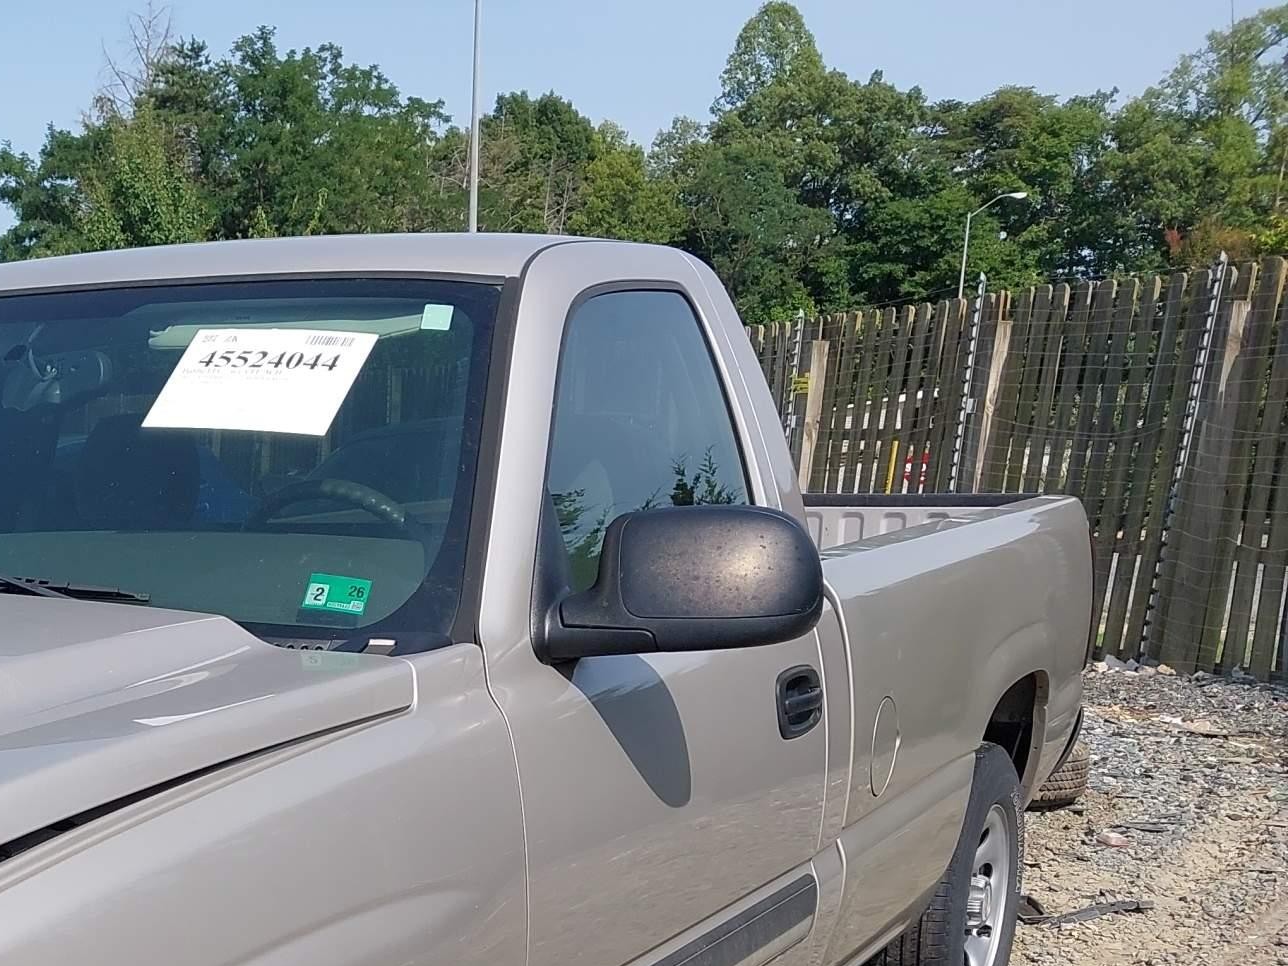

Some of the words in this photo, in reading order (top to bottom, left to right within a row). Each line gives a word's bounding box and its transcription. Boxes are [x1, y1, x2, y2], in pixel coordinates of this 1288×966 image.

[198, 350, 341, 371] 45524044
[313, 587, 325, 601] 2
[348, 586, 365, 598] 26
